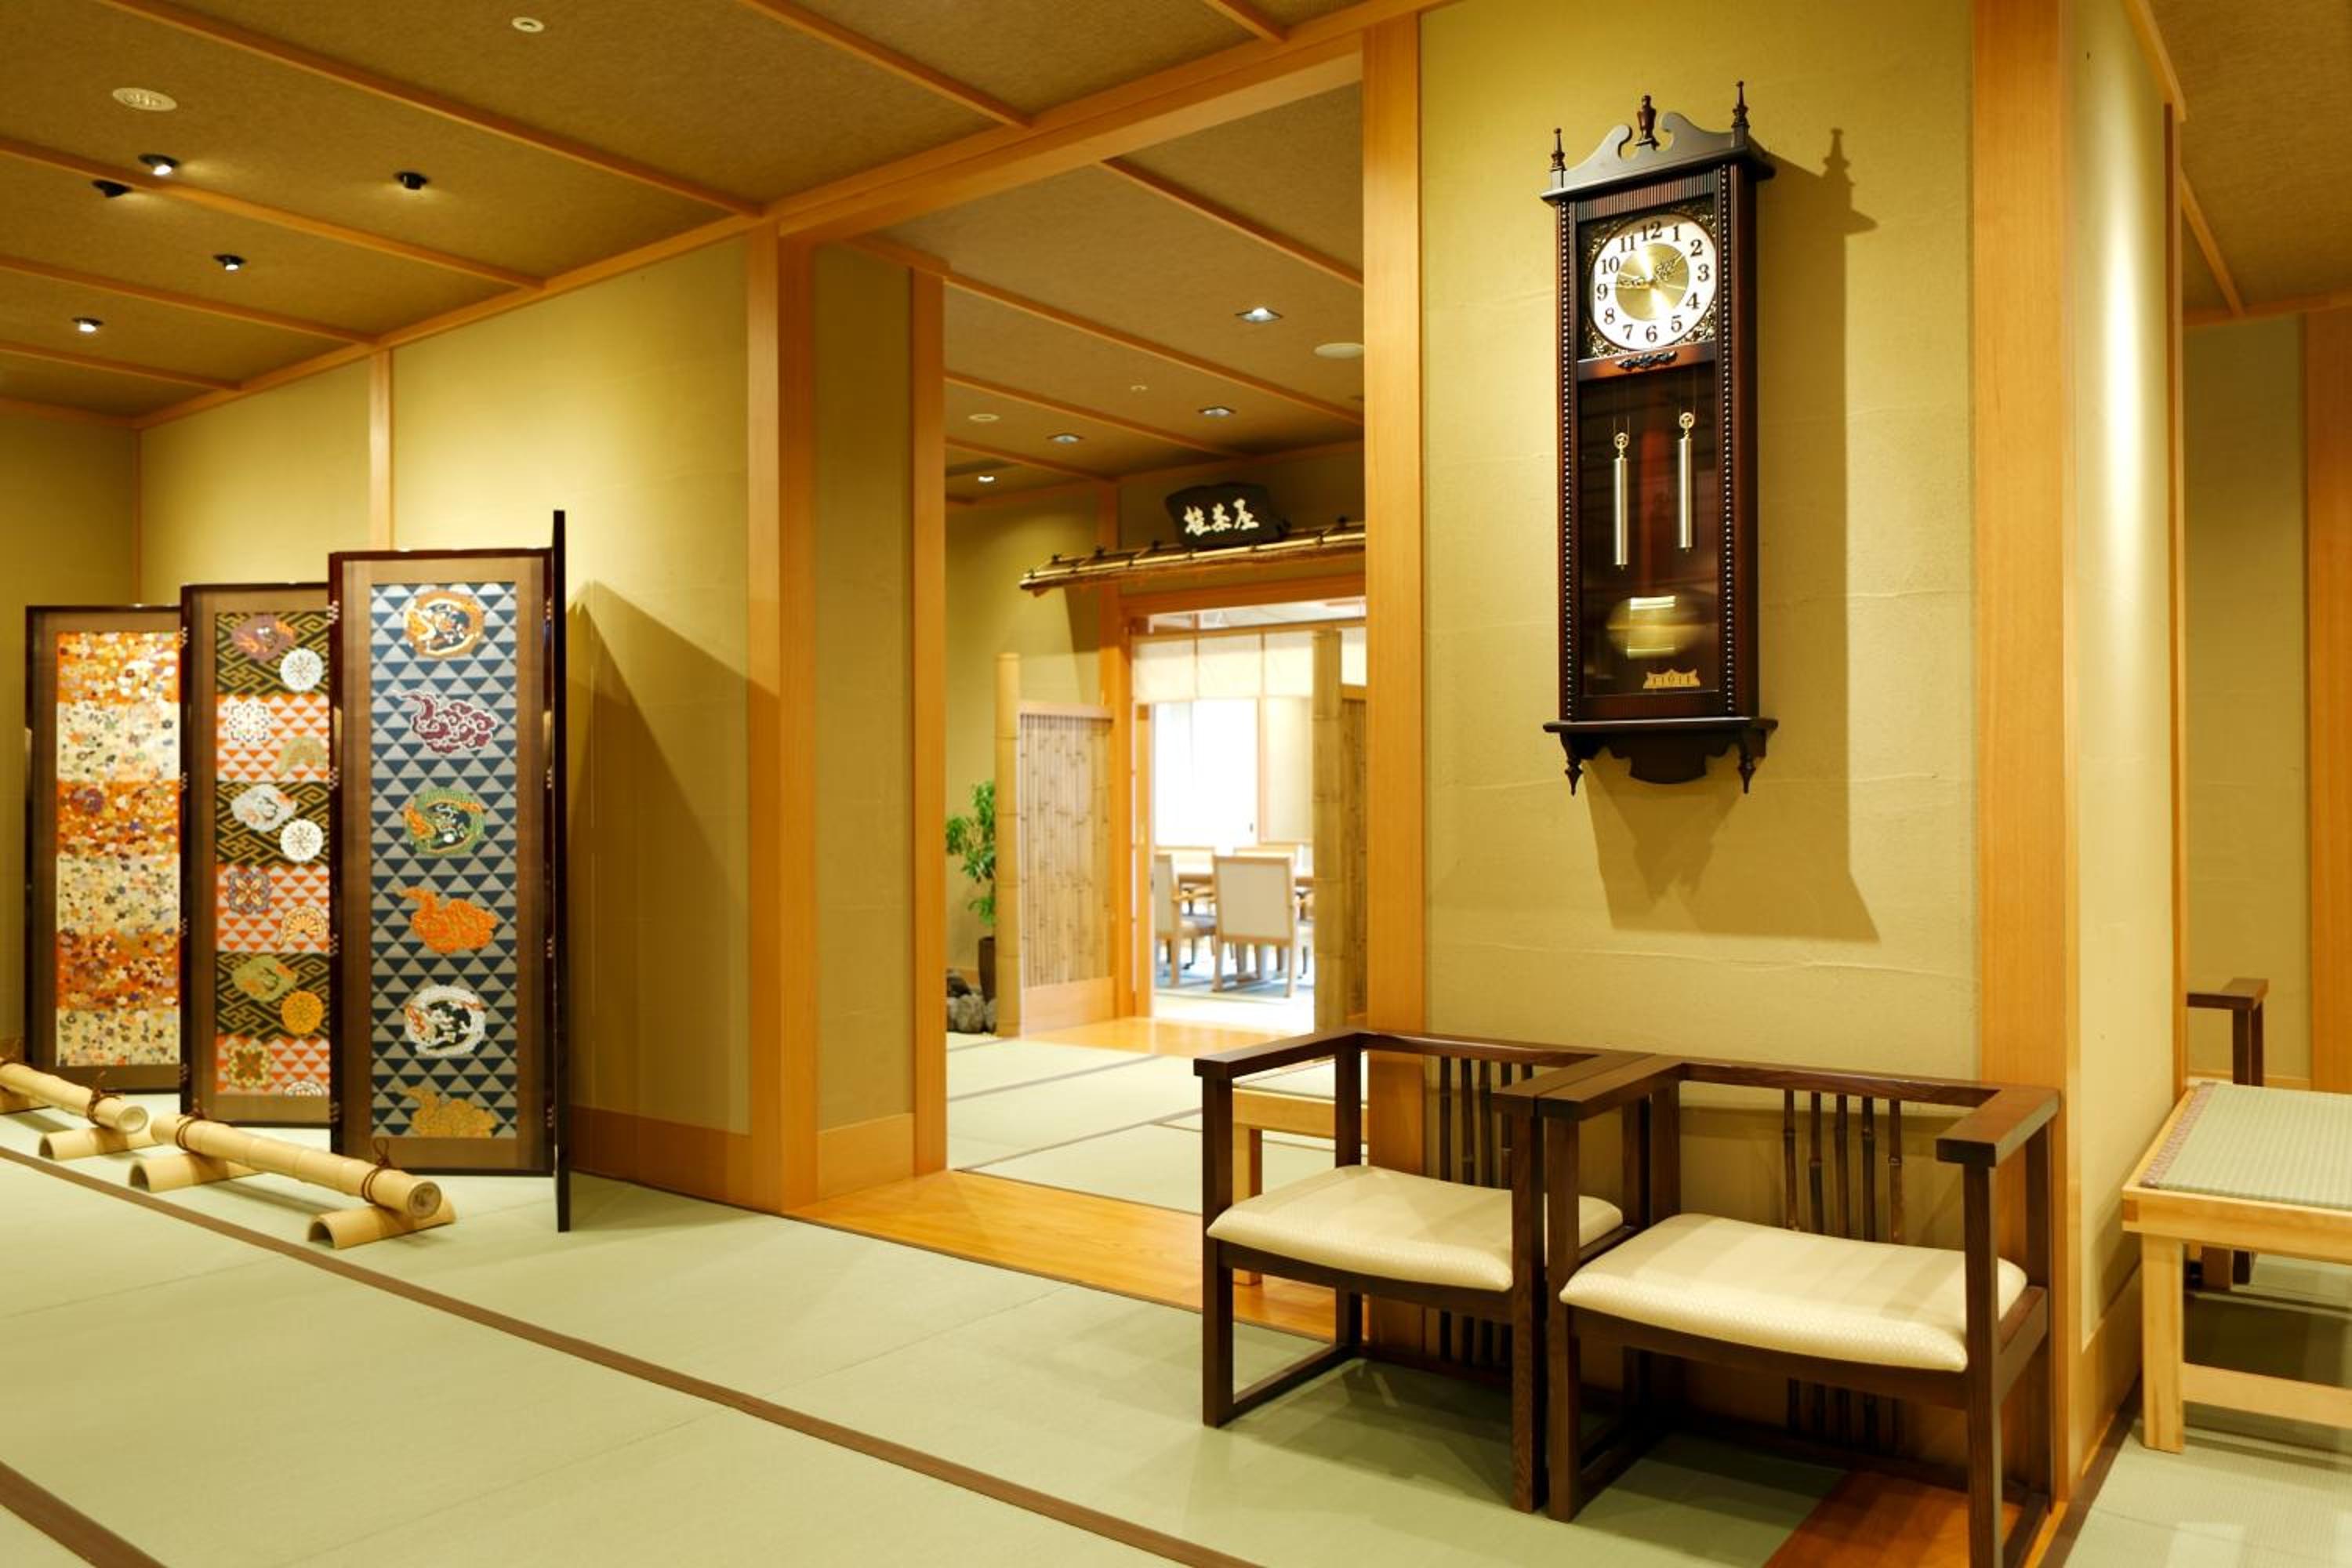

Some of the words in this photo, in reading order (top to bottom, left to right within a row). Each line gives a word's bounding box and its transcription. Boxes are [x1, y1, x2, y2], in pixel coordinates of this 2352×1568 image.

[1641, 221, 1662, 241] 12
[1672, 226, 1680, 241] 1
[1620, 234, 1636, 252] 11
[1690, 239, 1703, 257] 2
[1601, 256, 1620, 274] 10
[1697, 263, 1709, 282] 3
[1596, 283, 1607, 301] 9
[1686, 292, 1700, 309] 4
[1604, 307, 1615, 325] 8
[1671, 315, 1682, 332] 5
[1623, 324, 1633, 340] 7
[1646, 325, 1658, 342] 6
